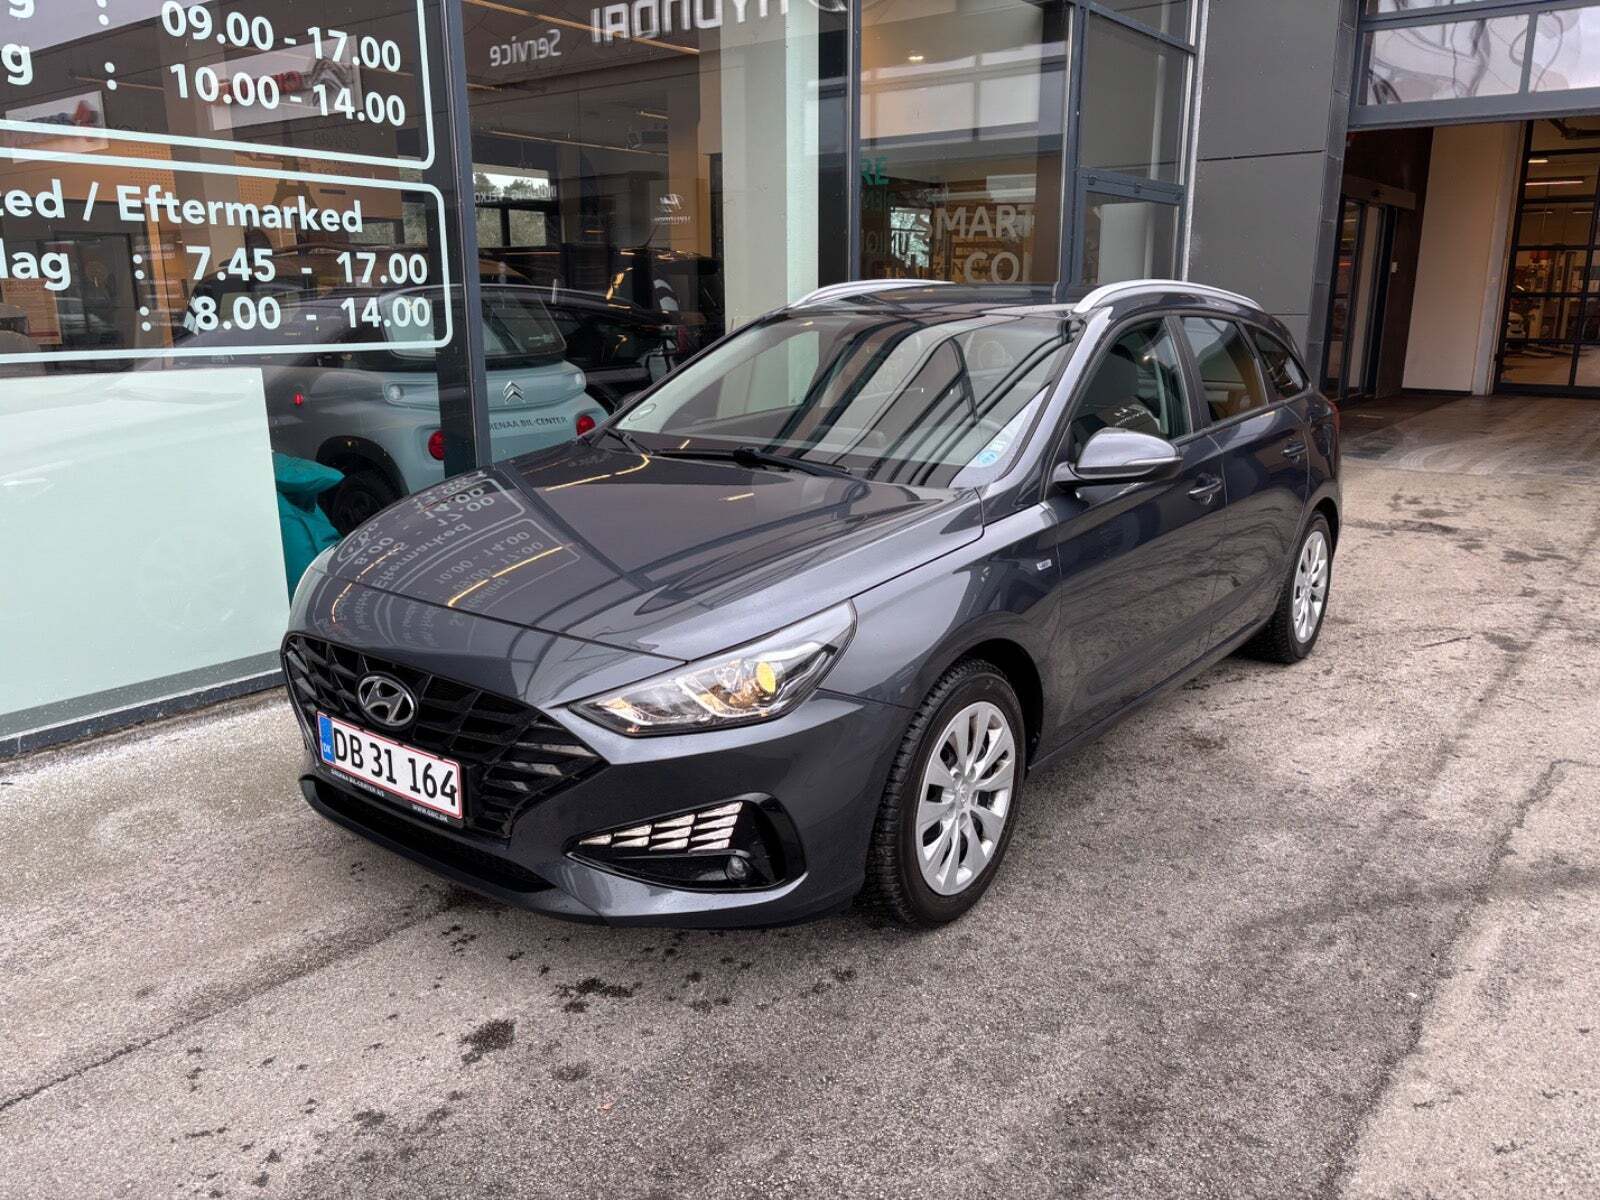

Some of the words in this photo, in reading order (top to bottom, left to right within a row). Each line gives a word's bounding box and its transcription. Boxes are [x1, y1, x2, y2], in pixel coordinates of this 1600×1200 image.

[162, 1, 274, 50] 09.00
[308, 27, 400, 72] 17.00
[170, 63, 279, 109] 10.00
[313, 84, 405, 126] 14.00
[0, 179, 65, 218] ed
[83, 181, 99, 221] /
[116, 184, 363, 233] Eftermarked
[186, 246, 276, 282] 7.45
[336, 252, 428, 284] 17.00
[195, 296, 281, 331] 8.00
[341, 297, 430, 328] 14.00
[334, 727, 363, 769] DB
[369, 742, 397, 785] 31
[408, 758, 457, 807] 164
